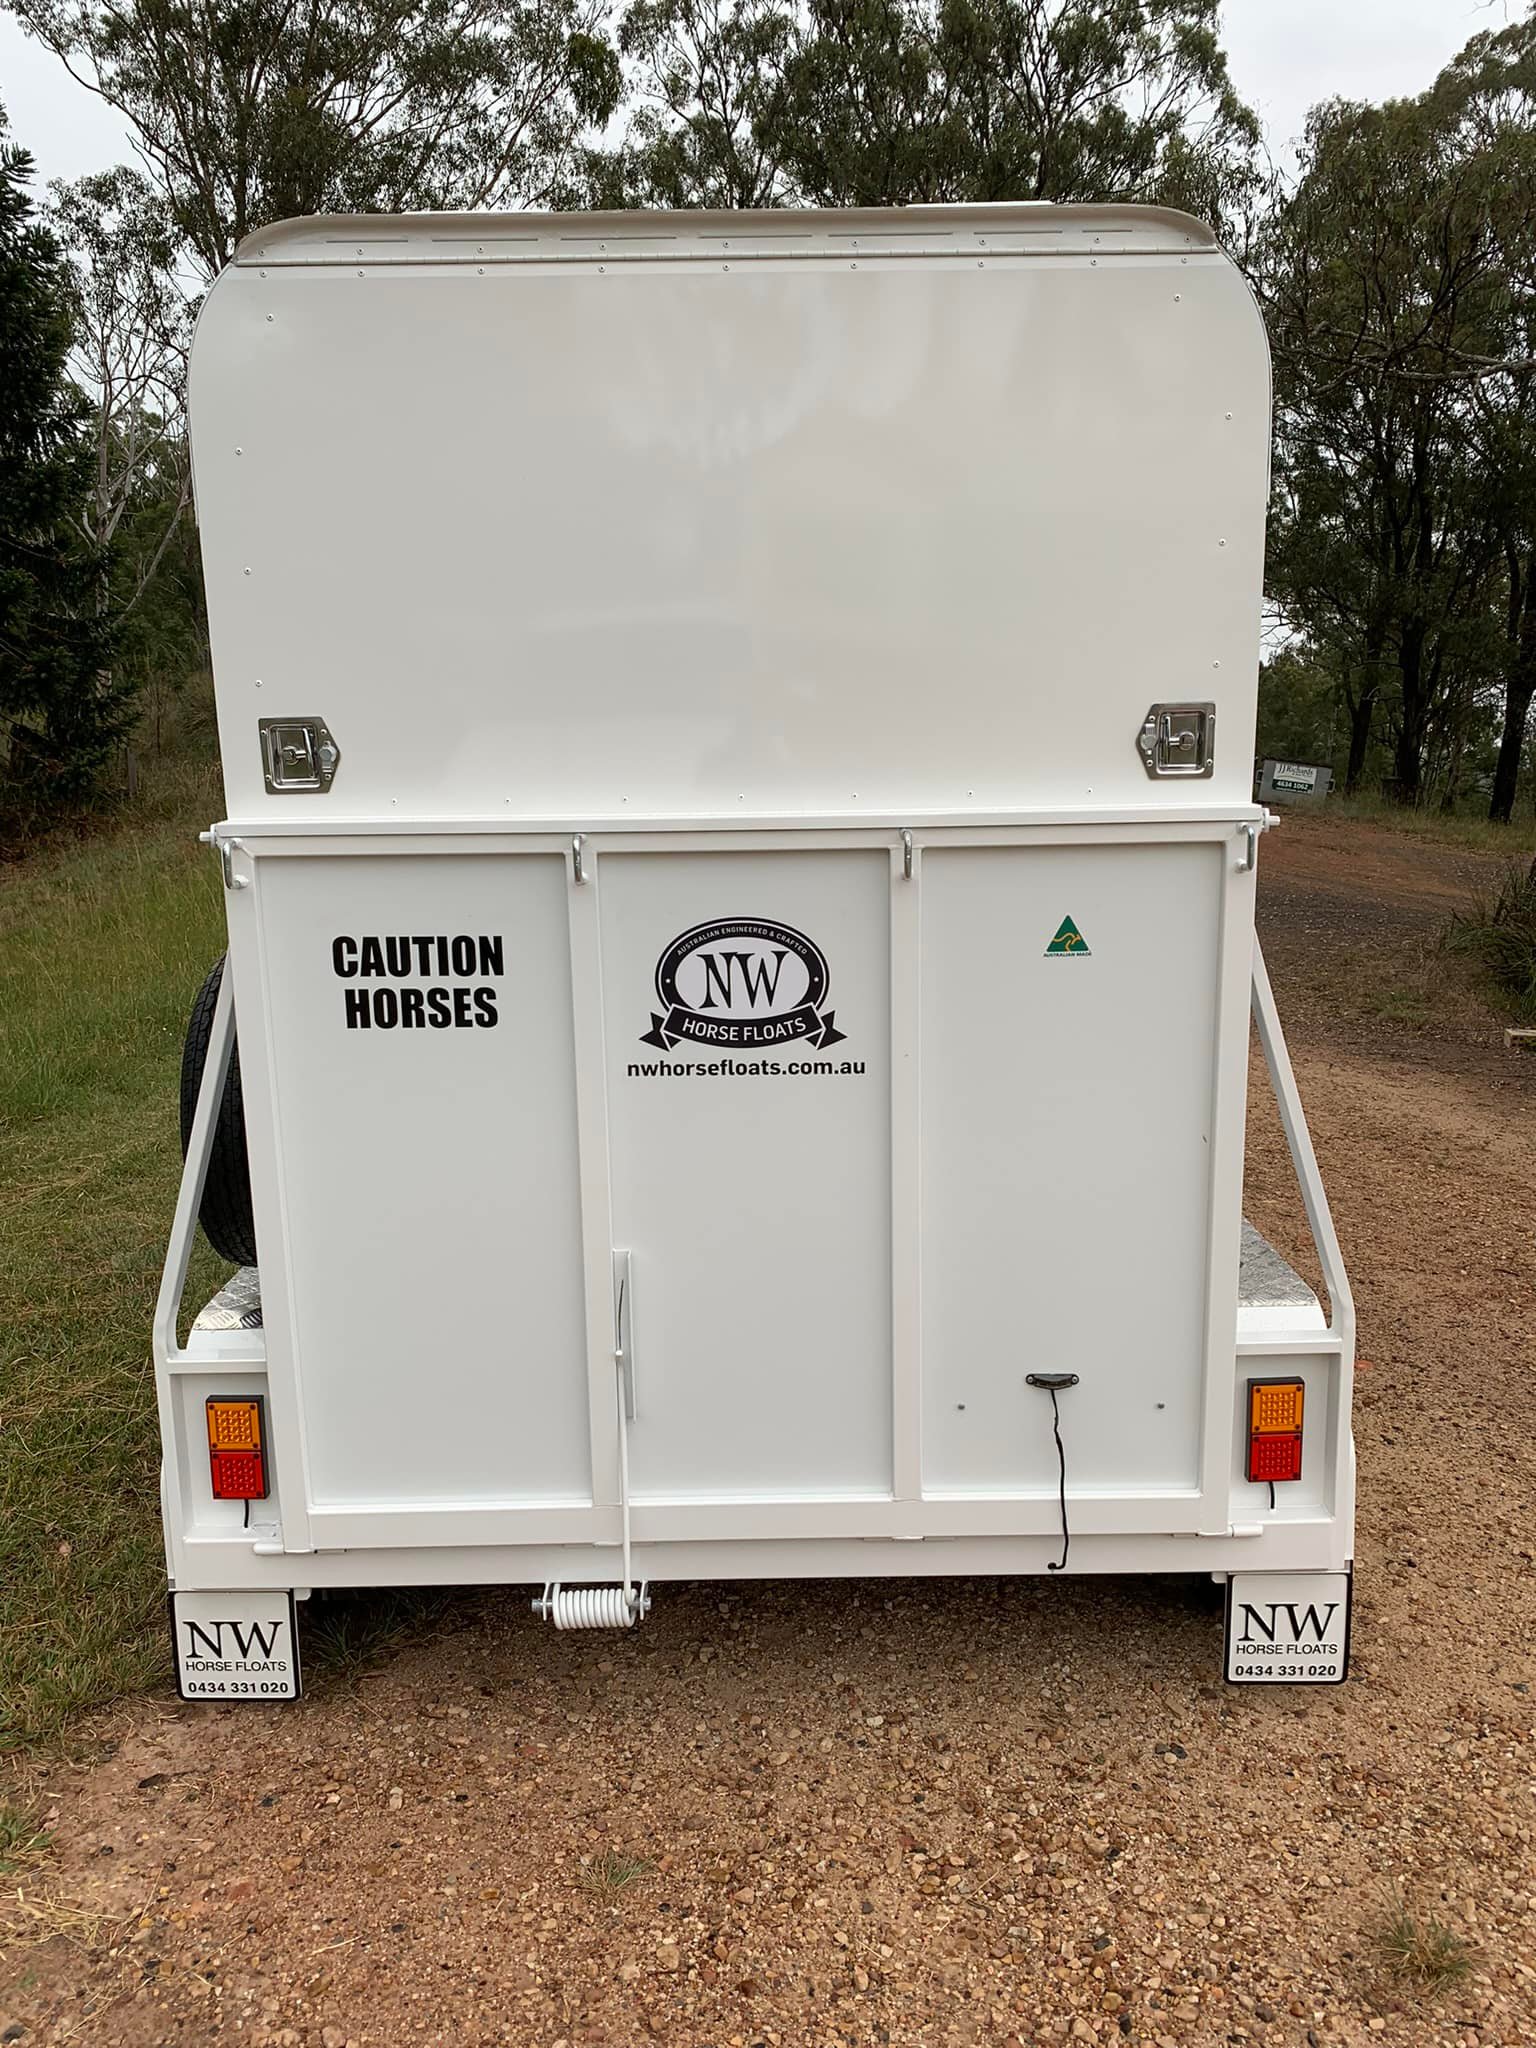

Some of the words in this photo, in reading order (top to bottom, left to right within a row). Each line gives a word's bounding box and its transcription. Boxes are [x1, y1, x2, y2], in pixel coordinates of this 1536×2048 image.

[677, 930, 720, 956] AUSTRALIAN
[721, 926, 768, 935] ENGINEERED
[776, 932, 808, 955] CRAFTED
[332, 935, 505, 978] CAUTION
[696, 950, 790, 1009] NW
[344, 986, 499, 1030] HORSES
[682, 1018, 739, 1041] HORSE
[743, 1017, 807, 1041] FLOATS
[627, 1059, 866, 1077] nwhorsefloats.com.au
[1237, 1603, 1340, 1642] NW
[182, 1621, 284, 1660] NW
[1236, 1644, 1283, 1655] HORSE
[1286, 1643, 1338, 1655] FLOATS
[185, 1661, 233, 1672] HORSE
[235, 1661, 288, 1672] FLOATS
[1235, 1665, 1273, 1676] 0434
[1277, 1665, 1304, 1676] 331
[1308, 1665, 1337, 1676] 020
[188, 1682, 226, 1693] 0434
[231, 1682, 257, 1693] 331
[260, 1682, 289, 1693] 020
